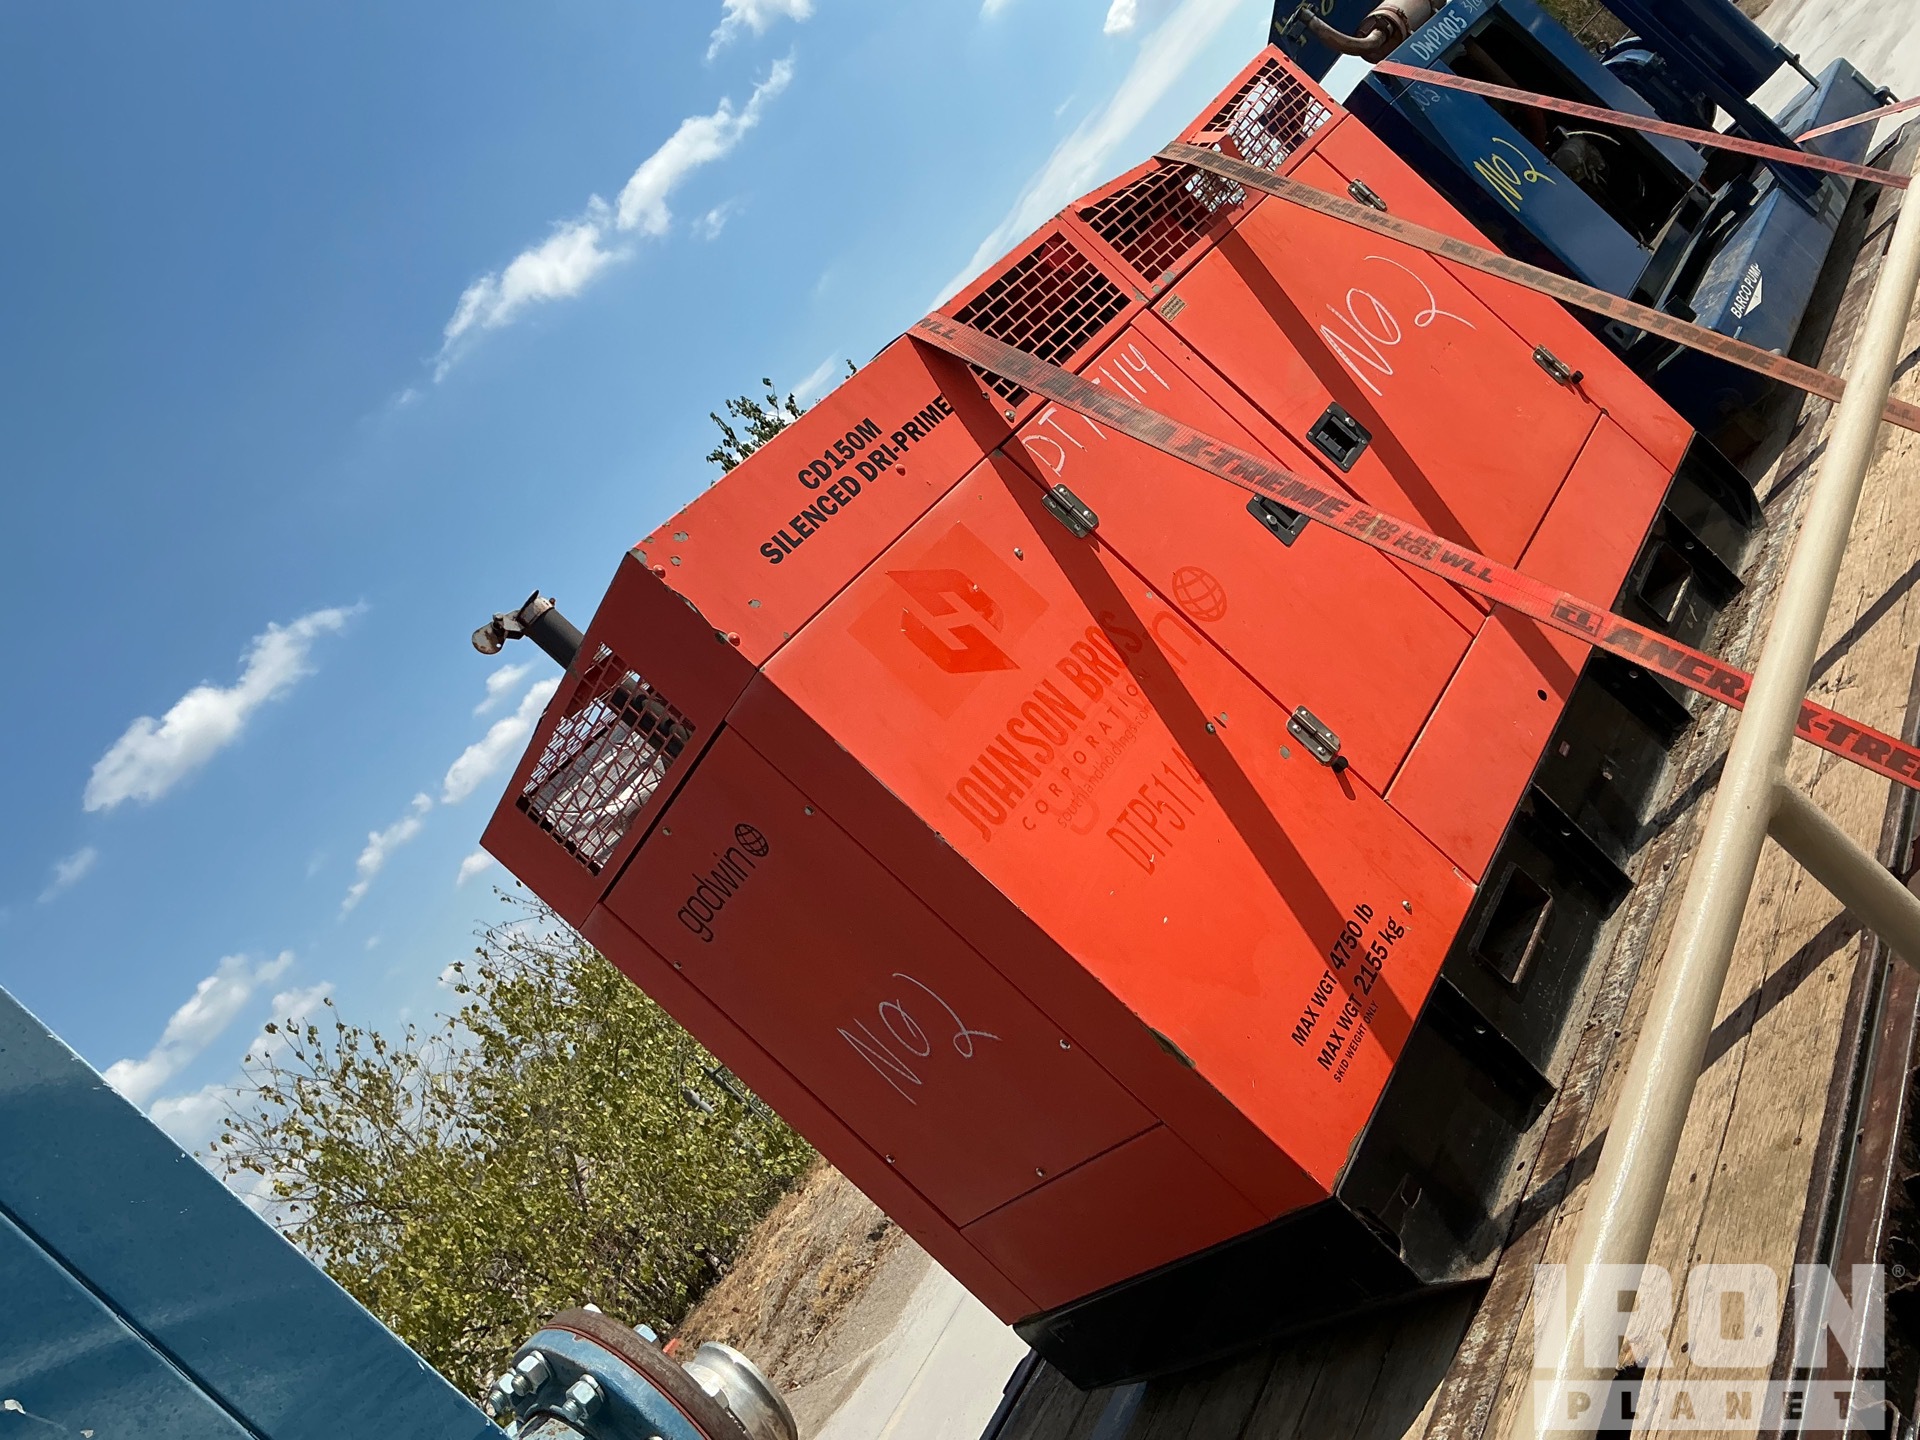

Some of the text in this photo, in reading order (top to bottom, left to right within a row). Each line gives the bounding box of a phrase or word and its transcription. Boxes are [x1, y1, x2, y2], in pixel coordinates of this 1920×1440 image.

[1410, 10, 1467, 61] DWP1005
[1730, 262, 1762, 319] BARCO PUMP
[759, 393, 955, 565] SILENCED DRI-PRIME
[798, 418, 883, 491] CD150M
[1176, 435, 1351, 519] X-TREME
[1440, 550, 1493, 583] WLL
[945, 679, 1086, 842] JOHNSON
[1023, 668, 1151, 832] CORPORATION
[1796, 707, 1920, 783] X-TRE
[677, 844, 757, 943] godwin
[1291, 904, 1373, 1047] MAX WGT 4750 lb
[1317, 915, 1404, 1071] MAX WGT 2155 kg
[1333, 1000, 1379, 1083] SKID WEIGHT ONLY
